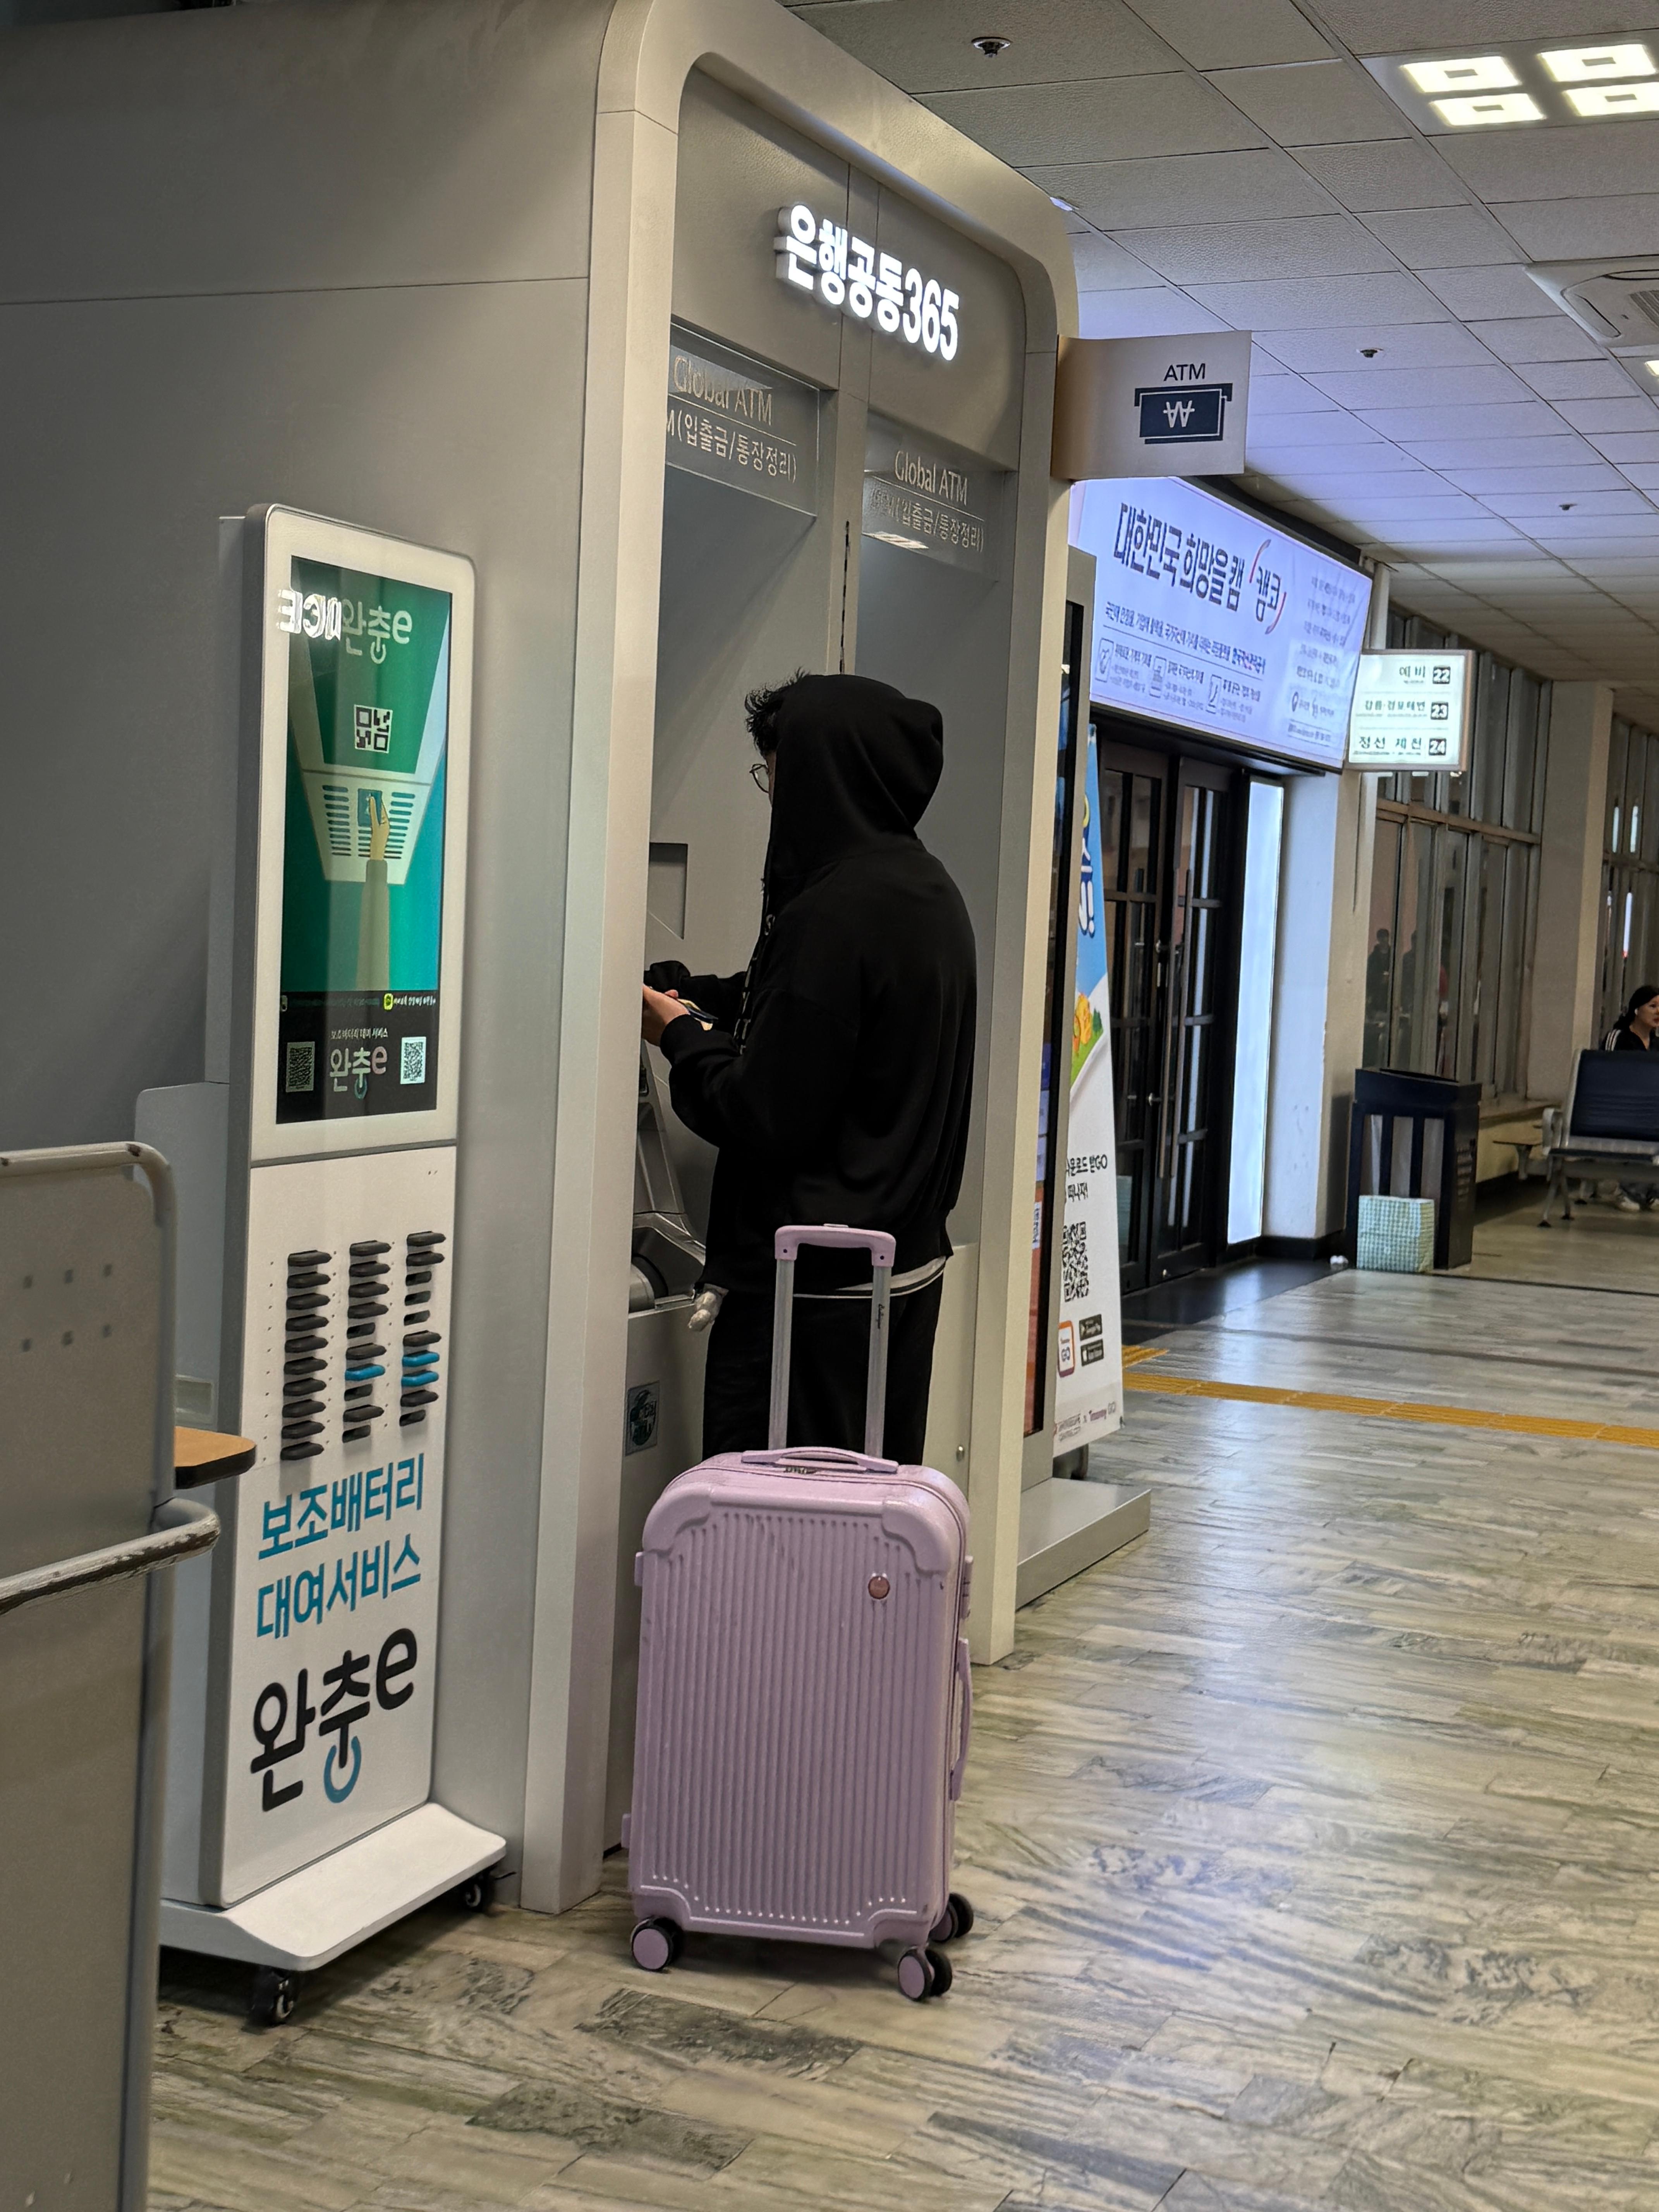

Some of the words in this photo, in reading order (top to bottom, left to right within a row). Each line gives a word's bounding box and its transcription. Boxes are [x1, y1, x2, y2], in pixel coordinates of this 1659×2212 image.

[786, 204, 960, 361] 은행공동365
[673, 355, 728, 409] Global
[735, 381, 772, 426] ATM
[1163, 363, 1206, 381] ATM
[895, 450, 936, 494] Global
[939, 468, 968, 506] ATM
[1113, 502, 1182, 587] 대한민국
[1180, 533, 1228, 605] 희망을
[1227, 555, 1245, 612] 캠
[1255, 566, 1281, 622] 캠코
[1433, 668, 1450, 684] 22
[1432, 704, 1448, 718] 23
[1429, 740, 1446, 754] 24
[258, 1452, 424, 1561] 보조배터리
[257, 1533, 421, 1639] 대여서비스
[250, 1627, 417, 1812] 완충e
